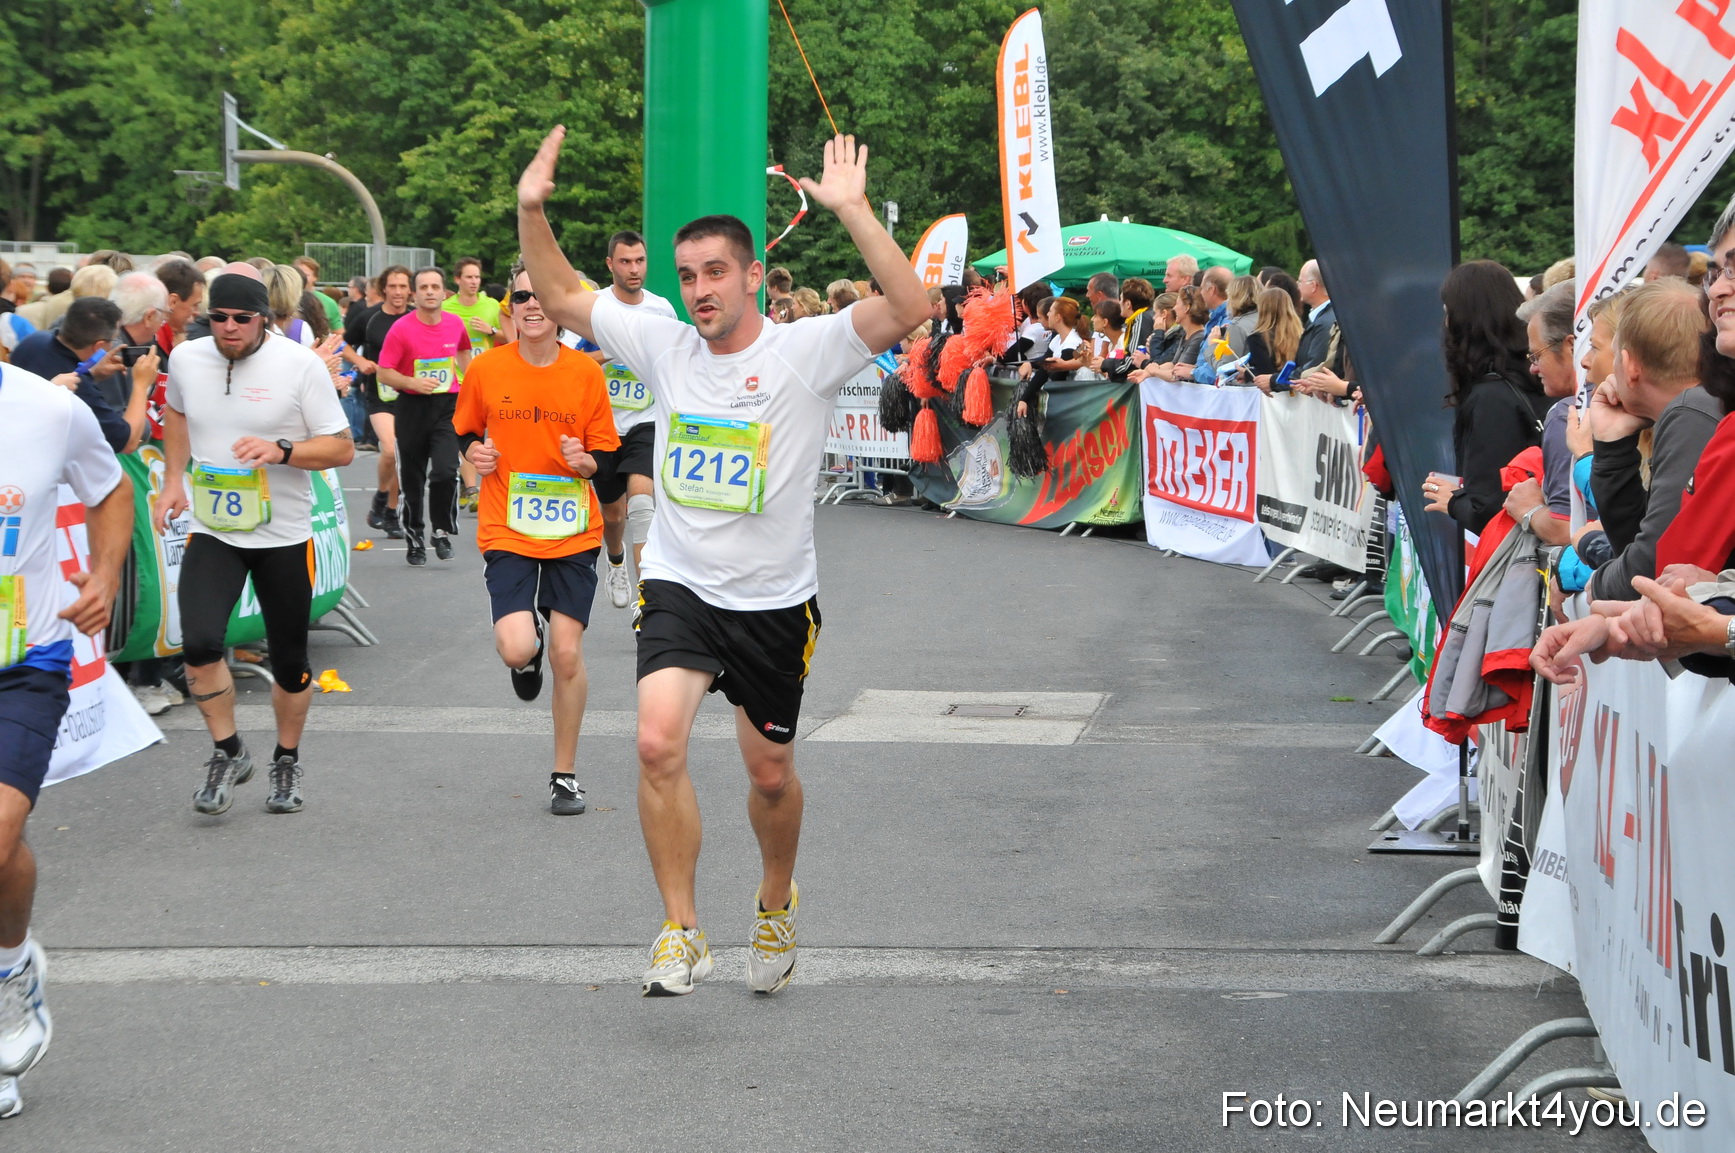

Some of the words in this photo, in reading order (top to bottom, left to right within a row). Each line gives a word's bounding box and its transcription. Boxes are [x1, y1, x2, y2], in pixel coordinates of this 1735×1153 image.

[1611, 26, 1713, 172] XL
[1675, 0, 1735, 60] P
[1013, 43, 1033, 200] KLEBL
[1033, 56, 1049, 162] www.klebl.de
[924, 241, 948, 290] BL
[1141, 267, 1168, 275] Lamm
[609, 379, 645, 400] 918
[839, 382, 881, 396] rischman
[499, 409, 532, 420] EURO
[543, 411, 577, 425] POLES
[668, 446, 750, 487] 1212
[1153, 418, 1249, 512] MEIER
[679, 482, 704, 493] Stefan
[208, 489, 243, 517] 78
[512, 496, 577, 522] 1356
[169, 519, 188, 537] Neum
[164, 540, 184, 567] Lam
[1559, 684, 1583, 769] EU!
[1499, 900, 1522, 915] häu
[1673, 898, 1735, 1076] Fri
